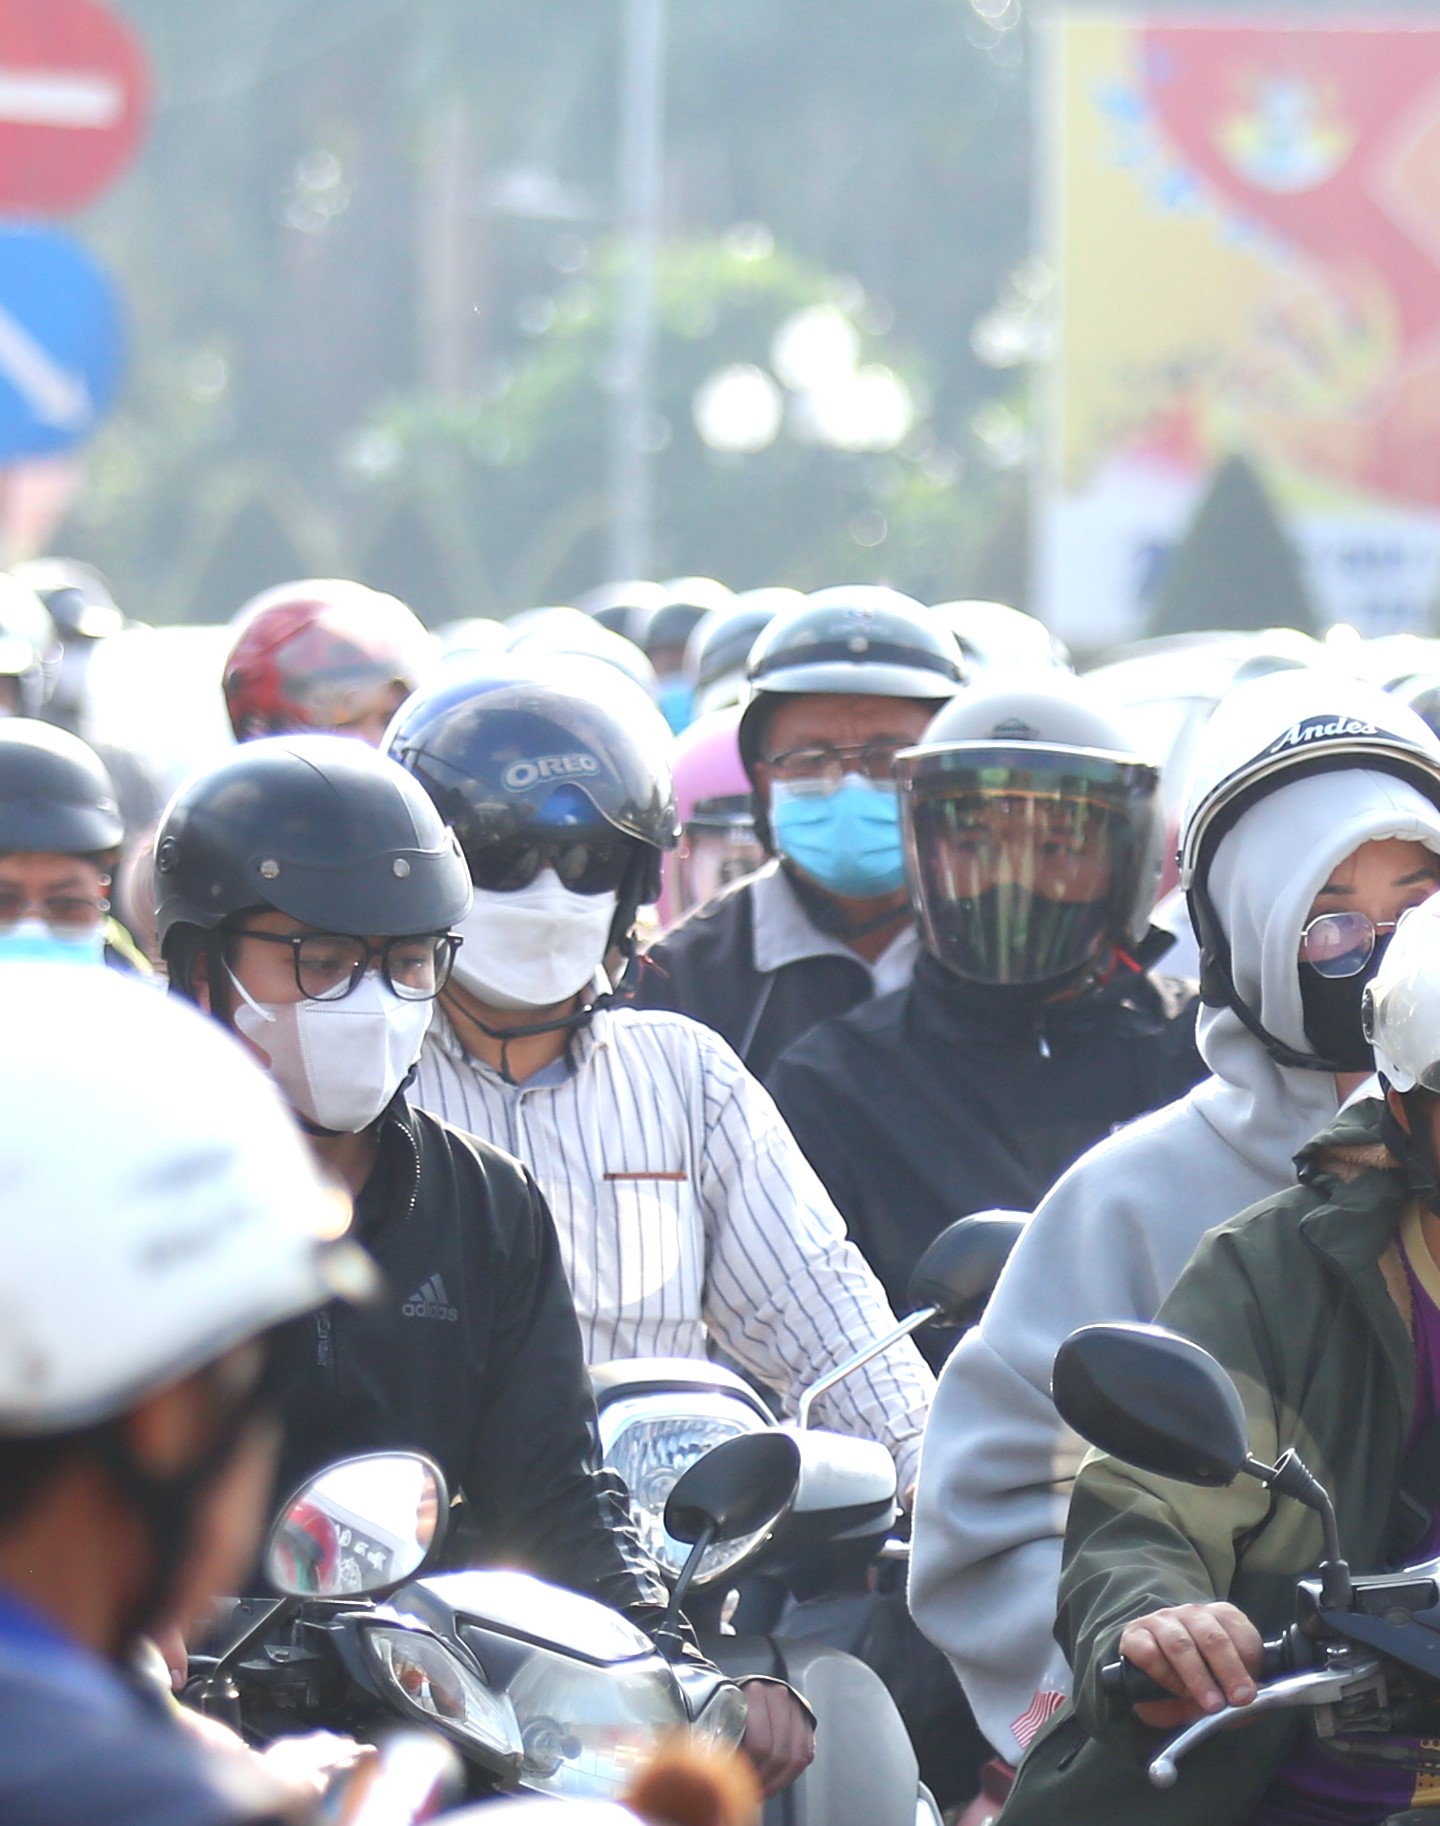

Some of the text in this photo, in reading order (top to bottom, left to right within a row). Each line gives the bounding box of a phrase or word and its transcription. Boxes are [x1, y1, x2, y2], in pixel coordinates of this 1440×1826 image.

[1270, 716, 1378, 753] Andes
[505, 756, 598, 788] OREO
[402, 1301, 458, 1321] adidas
